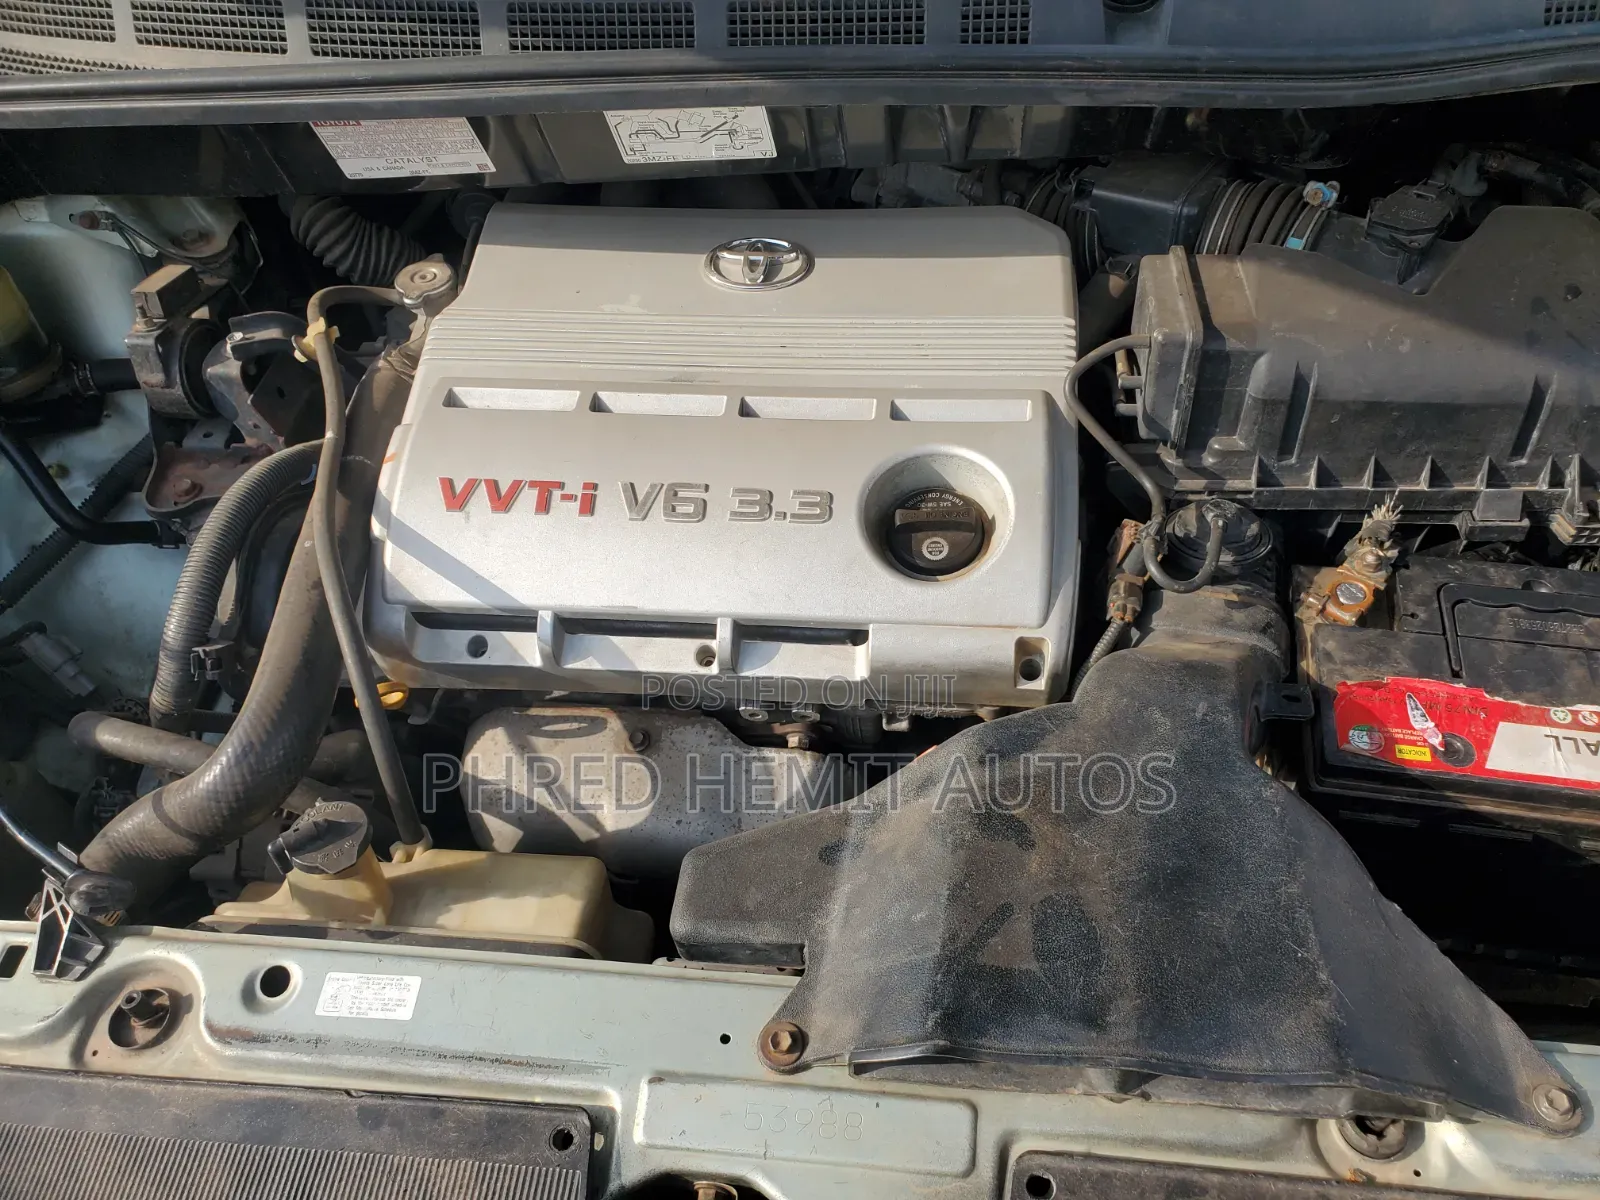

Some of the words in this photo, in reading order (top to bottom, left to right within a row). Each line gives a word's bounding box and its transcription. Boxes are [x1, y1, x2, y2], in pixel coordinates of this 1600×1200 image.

[385, 156, 439, 165] CATALYST
[438, 476, 599, 518] VVT-i
[617, 481, 710, 525] V6
[727, 486, 835, 525] 3.3
[942, 493, 964, 506] ENERGY
[1397, 748, 1428, 757] INDICATOR
[743, 1101, 864, 1141] 53988
